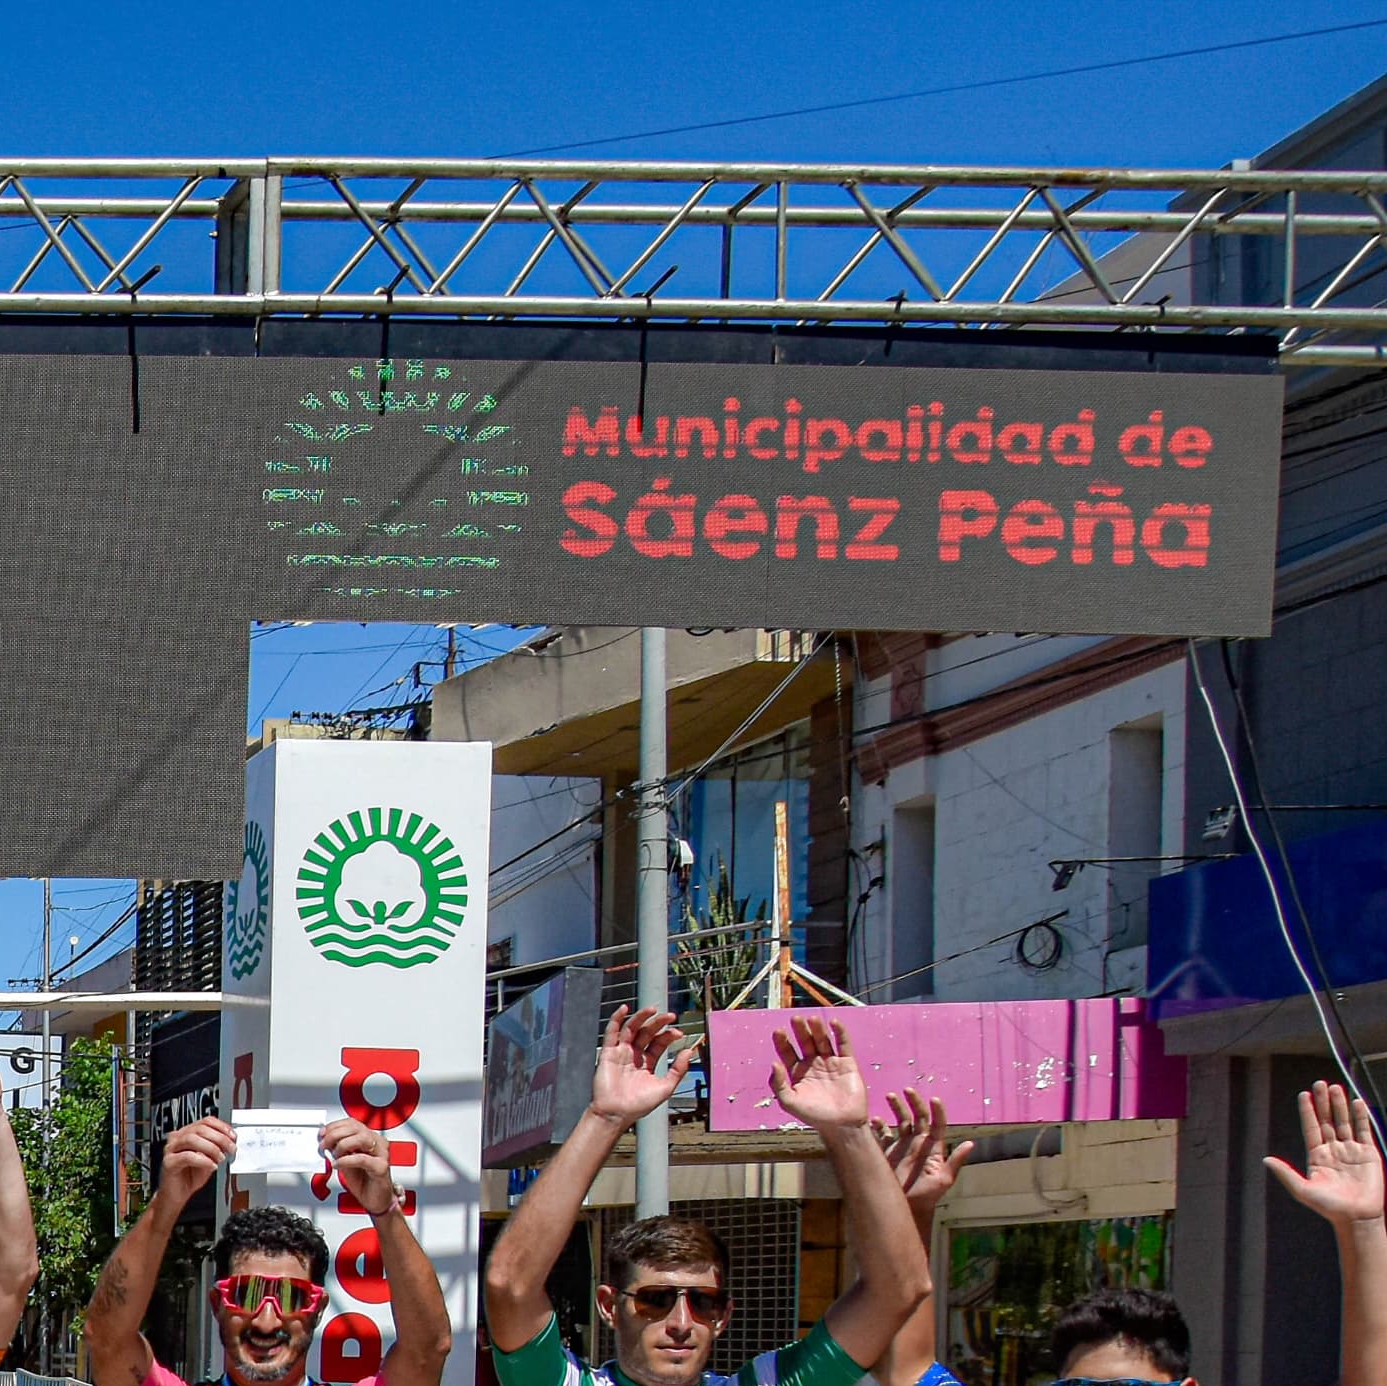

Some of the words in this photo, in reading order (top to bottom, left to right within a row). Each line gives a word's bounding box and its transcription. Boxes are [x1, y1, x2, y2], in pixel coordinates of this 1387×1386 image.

[561, 396, 1095, 473] Municipalidad
[1119, 410, 1213, 468] de
[560, 478, 901, 561] Sáenz
[939, 482, 1212, 568] Peña
